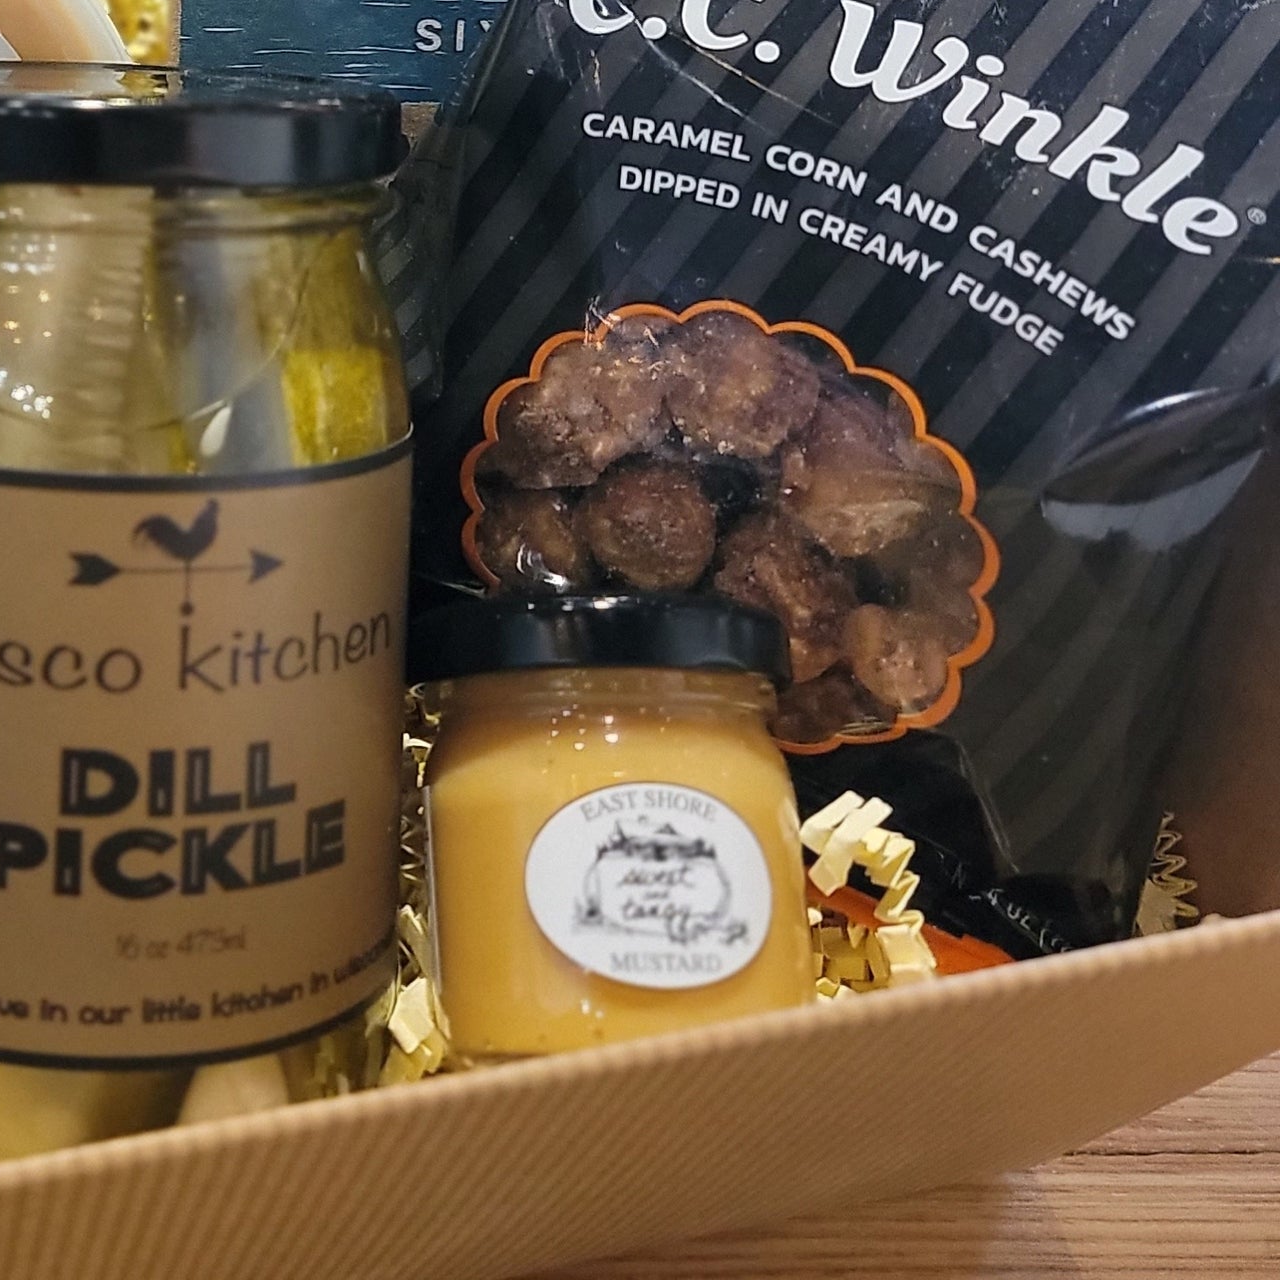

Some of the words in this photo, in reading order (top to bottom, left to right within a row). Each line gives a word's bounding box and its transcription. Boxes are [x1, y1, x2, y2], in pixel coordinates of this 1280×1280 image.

[581, 113, 750, 162] CARAMEL
[765, 145, 867, 199] CORN
[876, 184, 959, 235] AND
[968, 225, 1136, 342] CASHEWS
[620, 165, 740, 211] DIPPED
[752, 192, 787, 224] IN
[799, 209, 943, 282] CREAMY
[948, 273, 1065, 357] FUDGE
[178, 610, 391, 693] kitchen
[60, 741, 297, 817] DILL
[580, 791, 637, 822] EAST
[644, 790, 718, 821] SHORE
[611, 951, 723, 972] MUSTARD
[40, 999, 68, 1021] in
[79, 1005, 132, 1025] our
[211, 984, 303, 1018] kitchen
